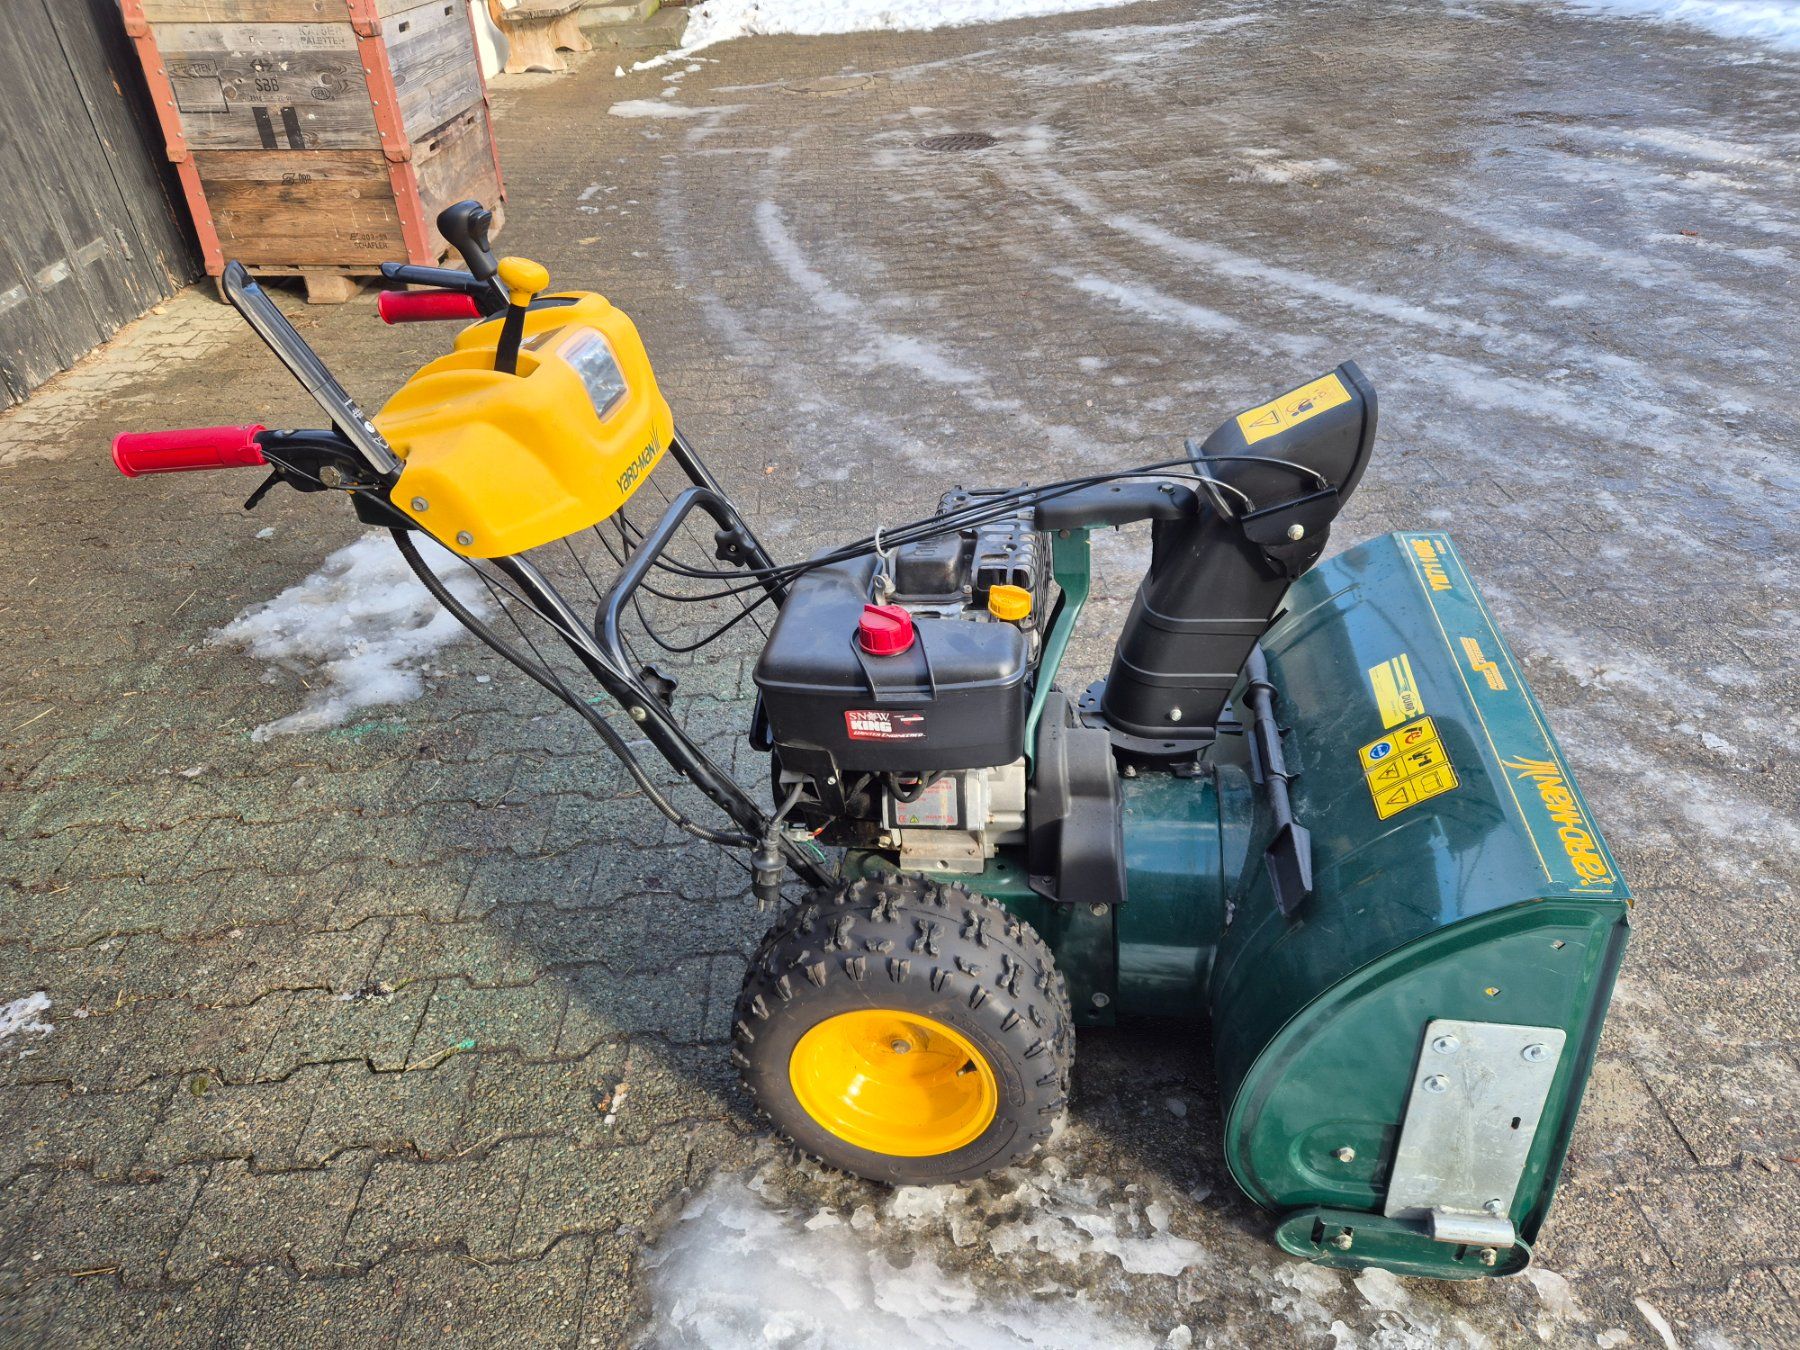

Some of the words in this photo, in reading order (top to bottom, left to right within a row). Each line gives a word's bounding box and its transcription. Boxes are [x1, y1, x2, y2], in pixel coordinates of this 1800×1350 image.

[255, 79, 280, 92] SBB
[849, 712, 890, 722] SNOW
[850, 720, 893, 733] KING
